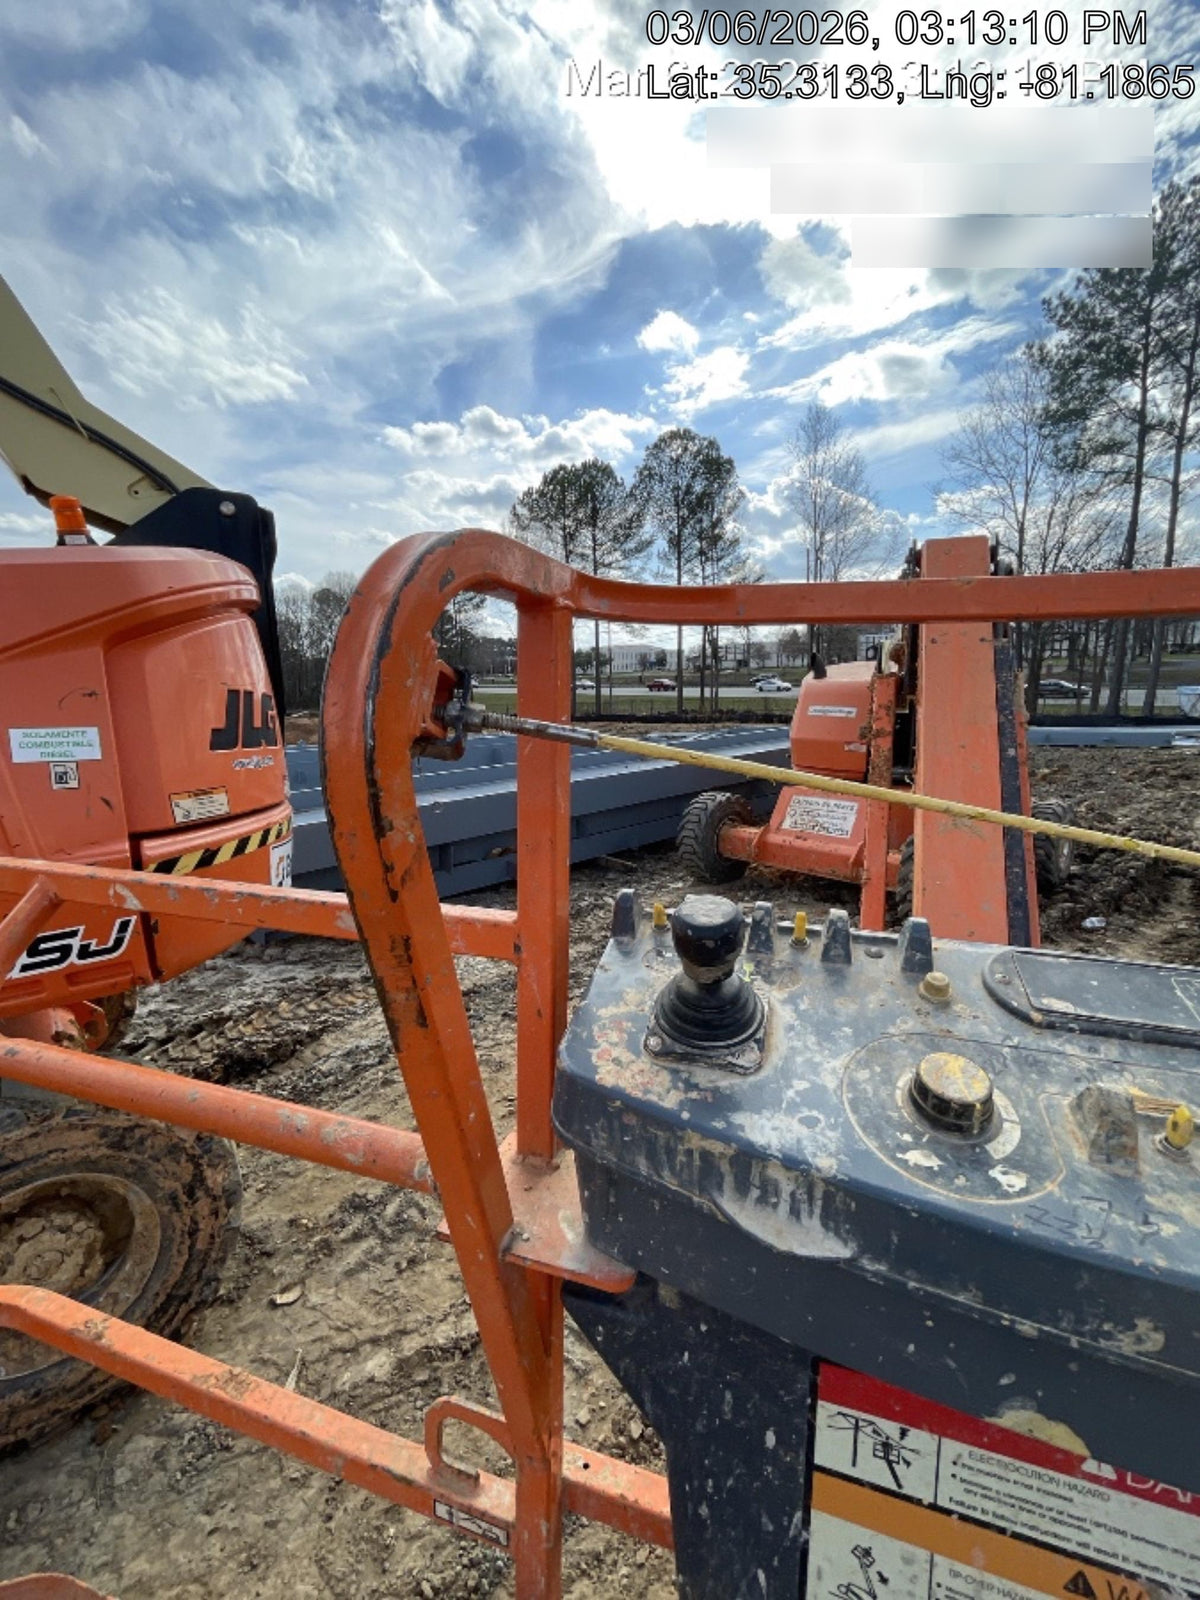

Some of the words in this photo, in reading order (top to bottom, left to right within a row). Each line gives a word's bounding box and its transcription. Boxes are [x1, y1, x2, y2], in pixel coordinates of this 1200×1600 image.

[19, 740, 94, 750] COMBUSTIBLE
[22, 730, 88, 739] SOLAMENTE
[10, 916, 136, 978] SJ
[968, 1450, 1061, 1487] ELECTROCUTION
[1063, 1480, 1111, 1503] HAZARD
